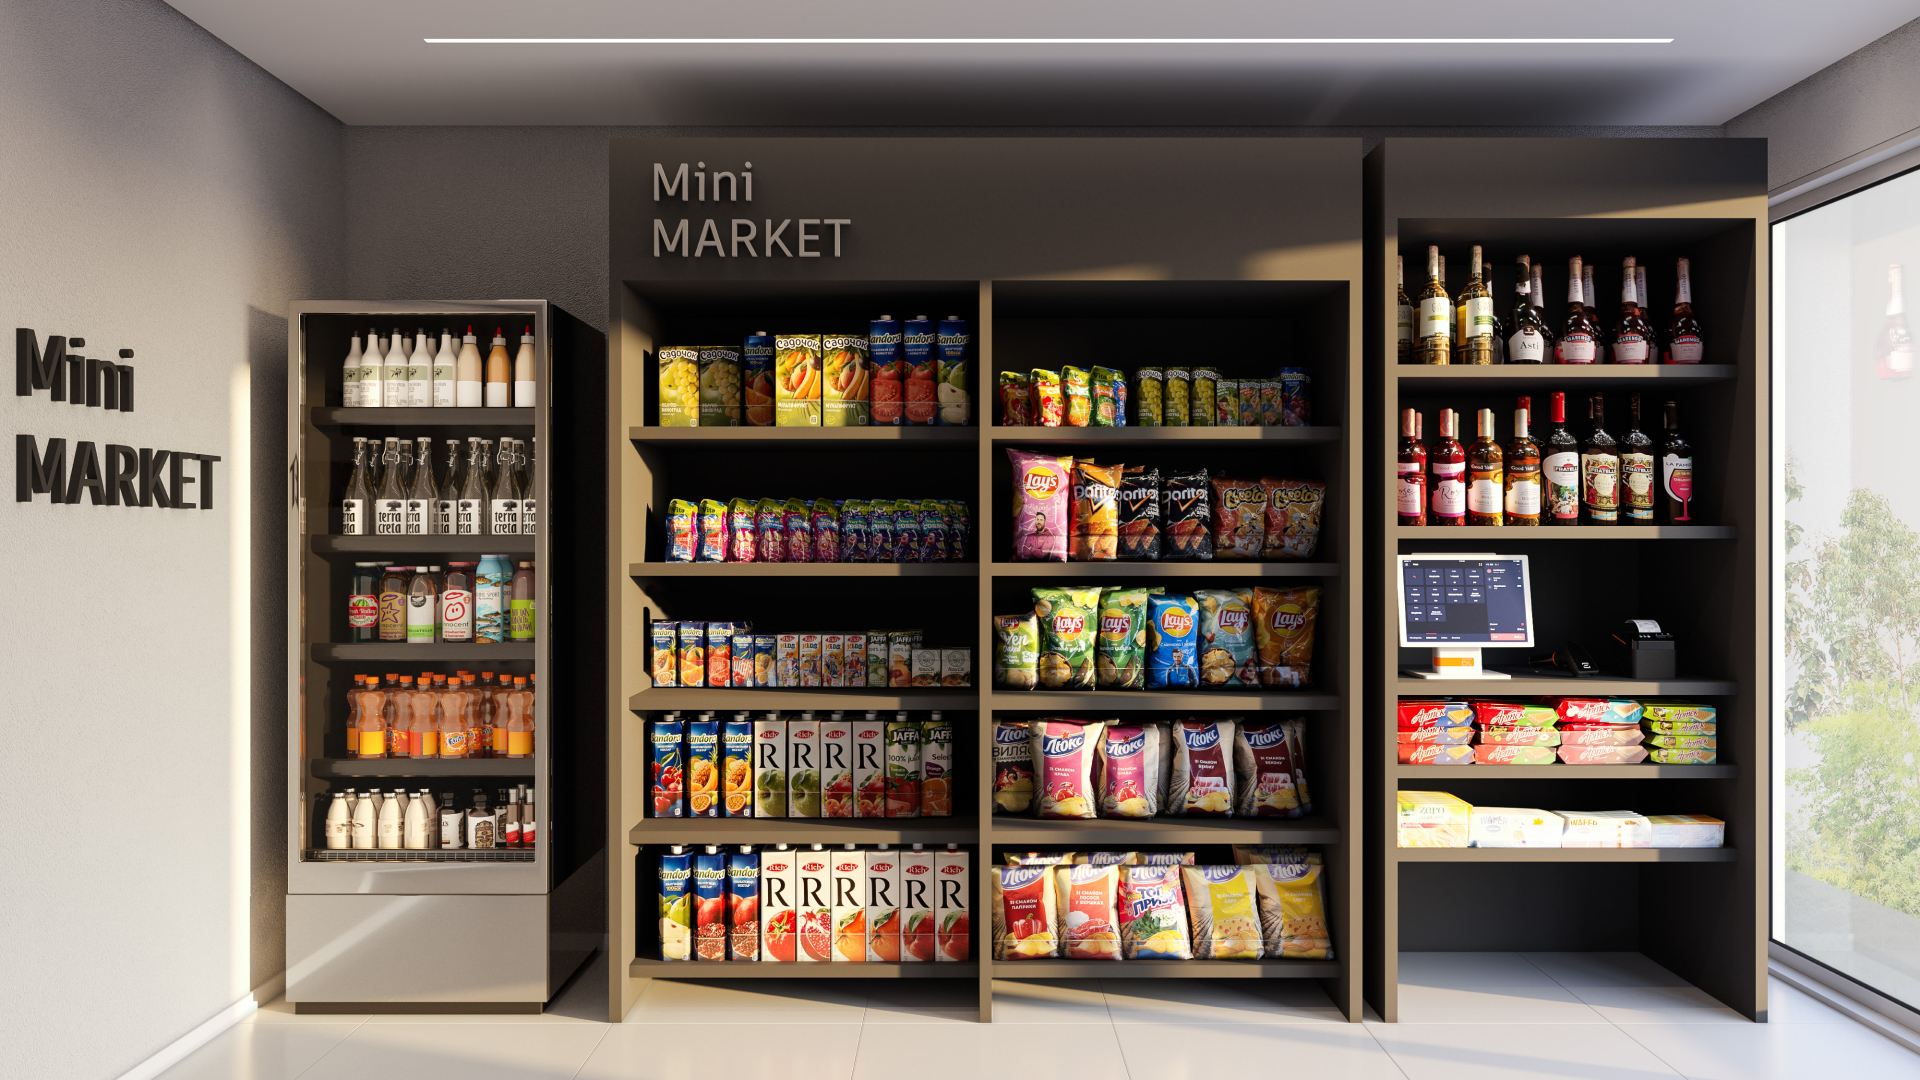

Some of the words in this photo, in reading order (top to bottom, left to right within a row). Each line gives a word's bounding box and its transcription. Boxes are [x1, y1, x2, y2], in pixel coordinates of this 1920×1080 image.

[654, 161, 752, 201] Mini
[653, 219, 851, 257] MARKET
[776, 338, 819, 350] Садочок
[824, 338, 868, 350] Садочок
[1520, 341, 1539, 349] Asti
[659, 350, 698, 360] Садочок
[700, 350, 739, 360] Садочок
[16, 328, 134, 412] Mini
[16, 434, 221, 509] MARKET
[1025, 473, 1057, 492] Lay's
[1272, 485, 1321, 509] Cheetos
[379, 512, 401, 522] terra
[495, 512, 517, 522] terra
[379, 523, 401, 533] creta
[495, 523, 517, 533] creta
[1001, 617, 1019, 628] Lay's
[1055, 616, 1083, 633] Lay's
[1100, 616, 1130, 633] Lay's
[1163, 613, 1191, 630] Lay's
[1220, 610, 1248, 627] Lay's
[1272, 612, 1304, 629] Lay's
[870, 635, 886, 644] JAFFA
[448, 735, 466, 746] Fanta
[651, 733, 682, 743] Sandora
[687, 733, 717, 743] Sandora
[722, 733, 752, 743] Sandora
[892, 731, 919, 741] JAFFA
[929, 730, 952, 740] JAFF
[997, 728, 1030, 742] Люк
[1186, 729, 1218, 746] Люкс
[1249, 729, 1284, 746] Люкс
[992, 745, 1032, 757] ВИЛЯ
[1045, 737, 1083, 754] Люкс
[1106, 738, 1144, 755] Люкс
[758, 743, 780, 768] R
[792, 743, 815, 768] R
[824, 743, 847, 768] R
[857, 743, 880, 769] R
[658, 867, 691, 880] Sandora
[693, 867, 725, 880] Sandora
[727, 864, 761, 877] Sandora
[909, 866, 925, 874] Rich
[944, 866, 960, 874] Rich
[765, 877, 790, 907] R
[801, 877, 826, 907] R
[834, 877, 860, 907] R
[869, 877, 894, 907] R
[904, 879, 930, 909] R
[939, 879, 965, 909] R
